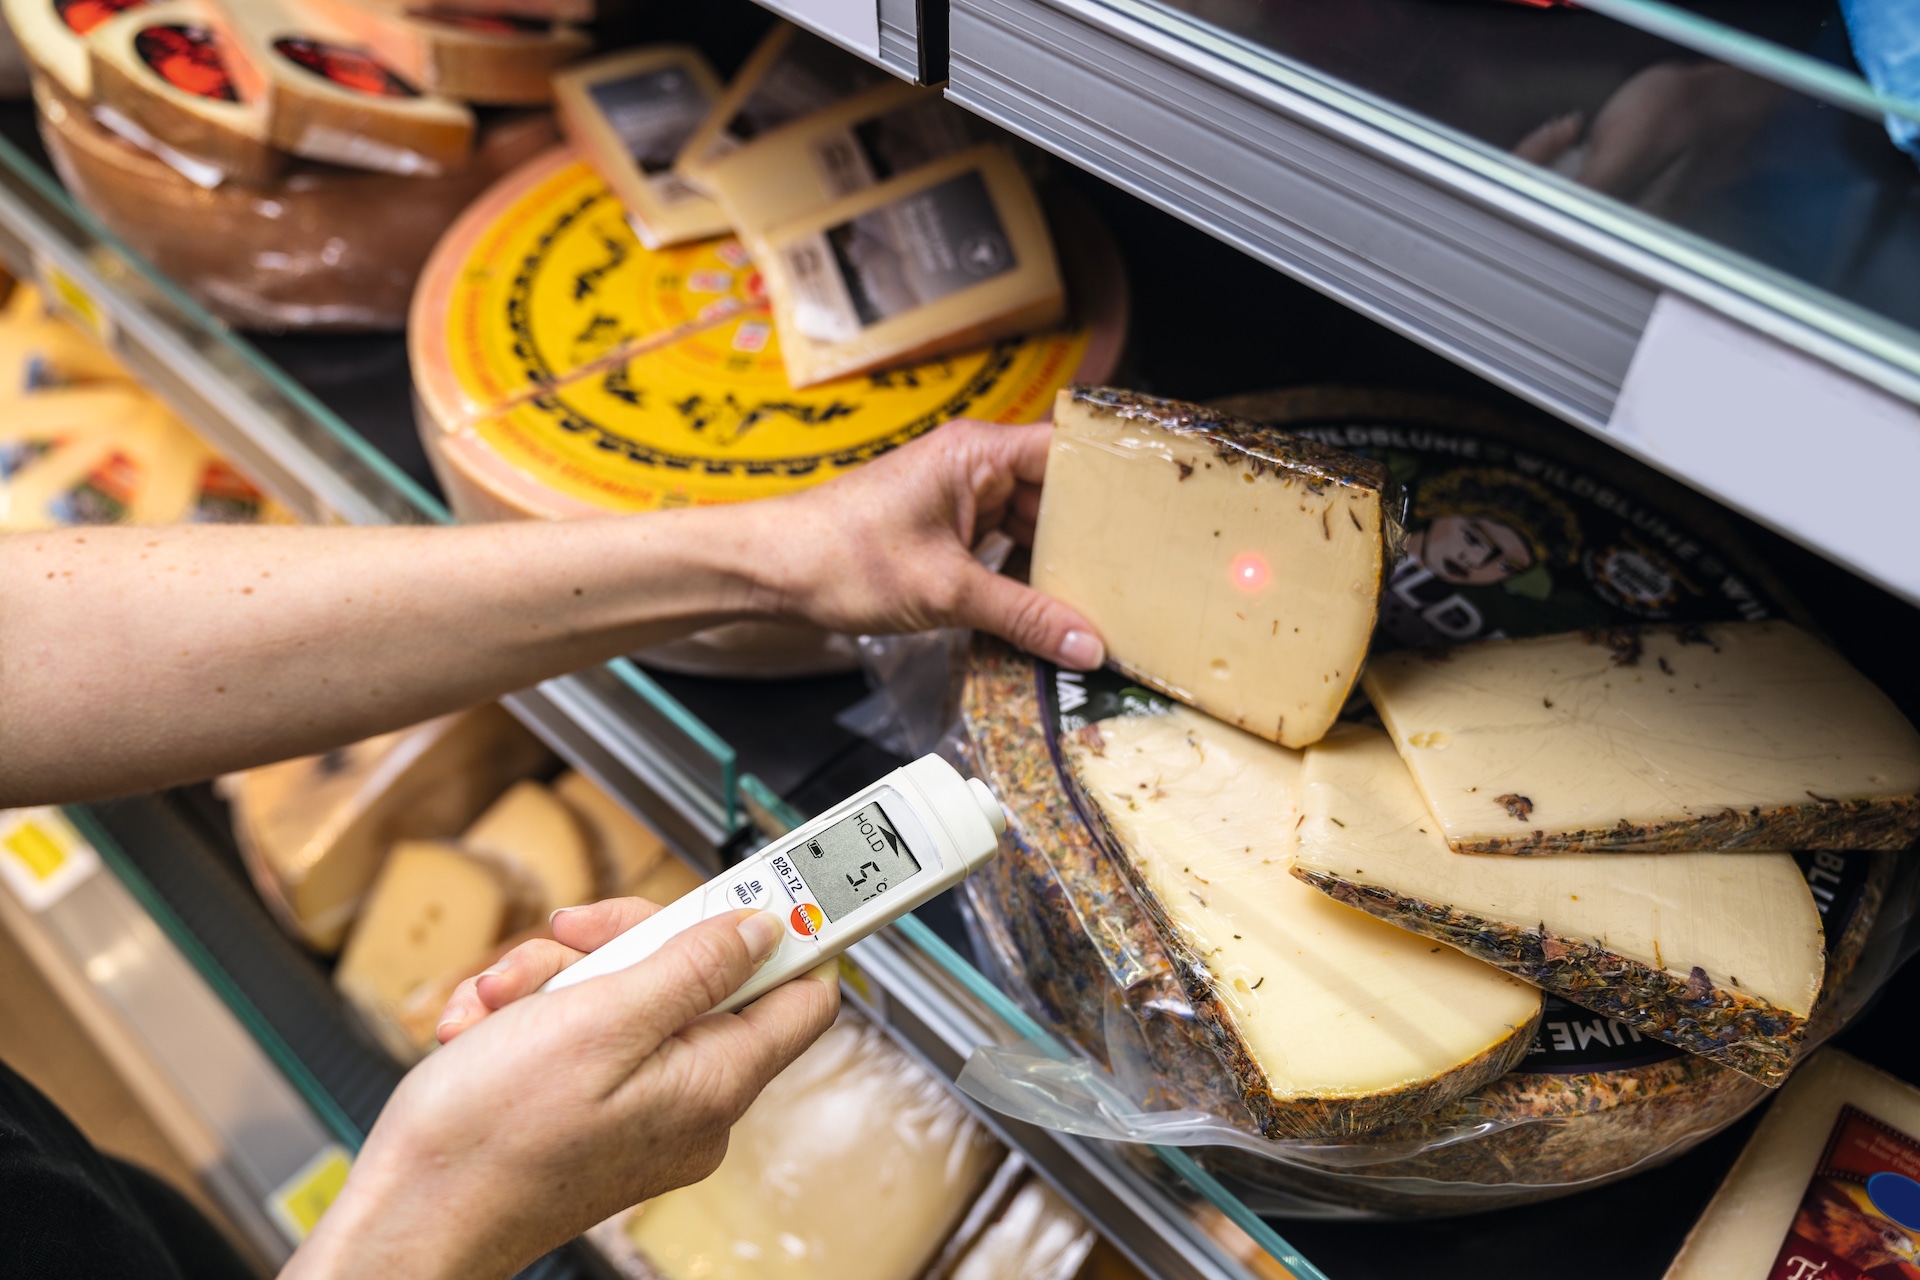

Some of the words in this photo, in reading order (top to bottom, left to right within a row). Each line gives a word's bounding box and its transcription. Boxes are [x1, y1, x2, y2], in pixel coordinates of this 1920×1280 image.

[853, 812, 885, 852] HOLD
[750, 880, 763, 894] ON
[772, 856, 803, 893] 826-T2
[733, 884, 752, 905] HOLD
[797, 904, 818, 936] testo
[1547, 1019, 1642, 1051] UME
